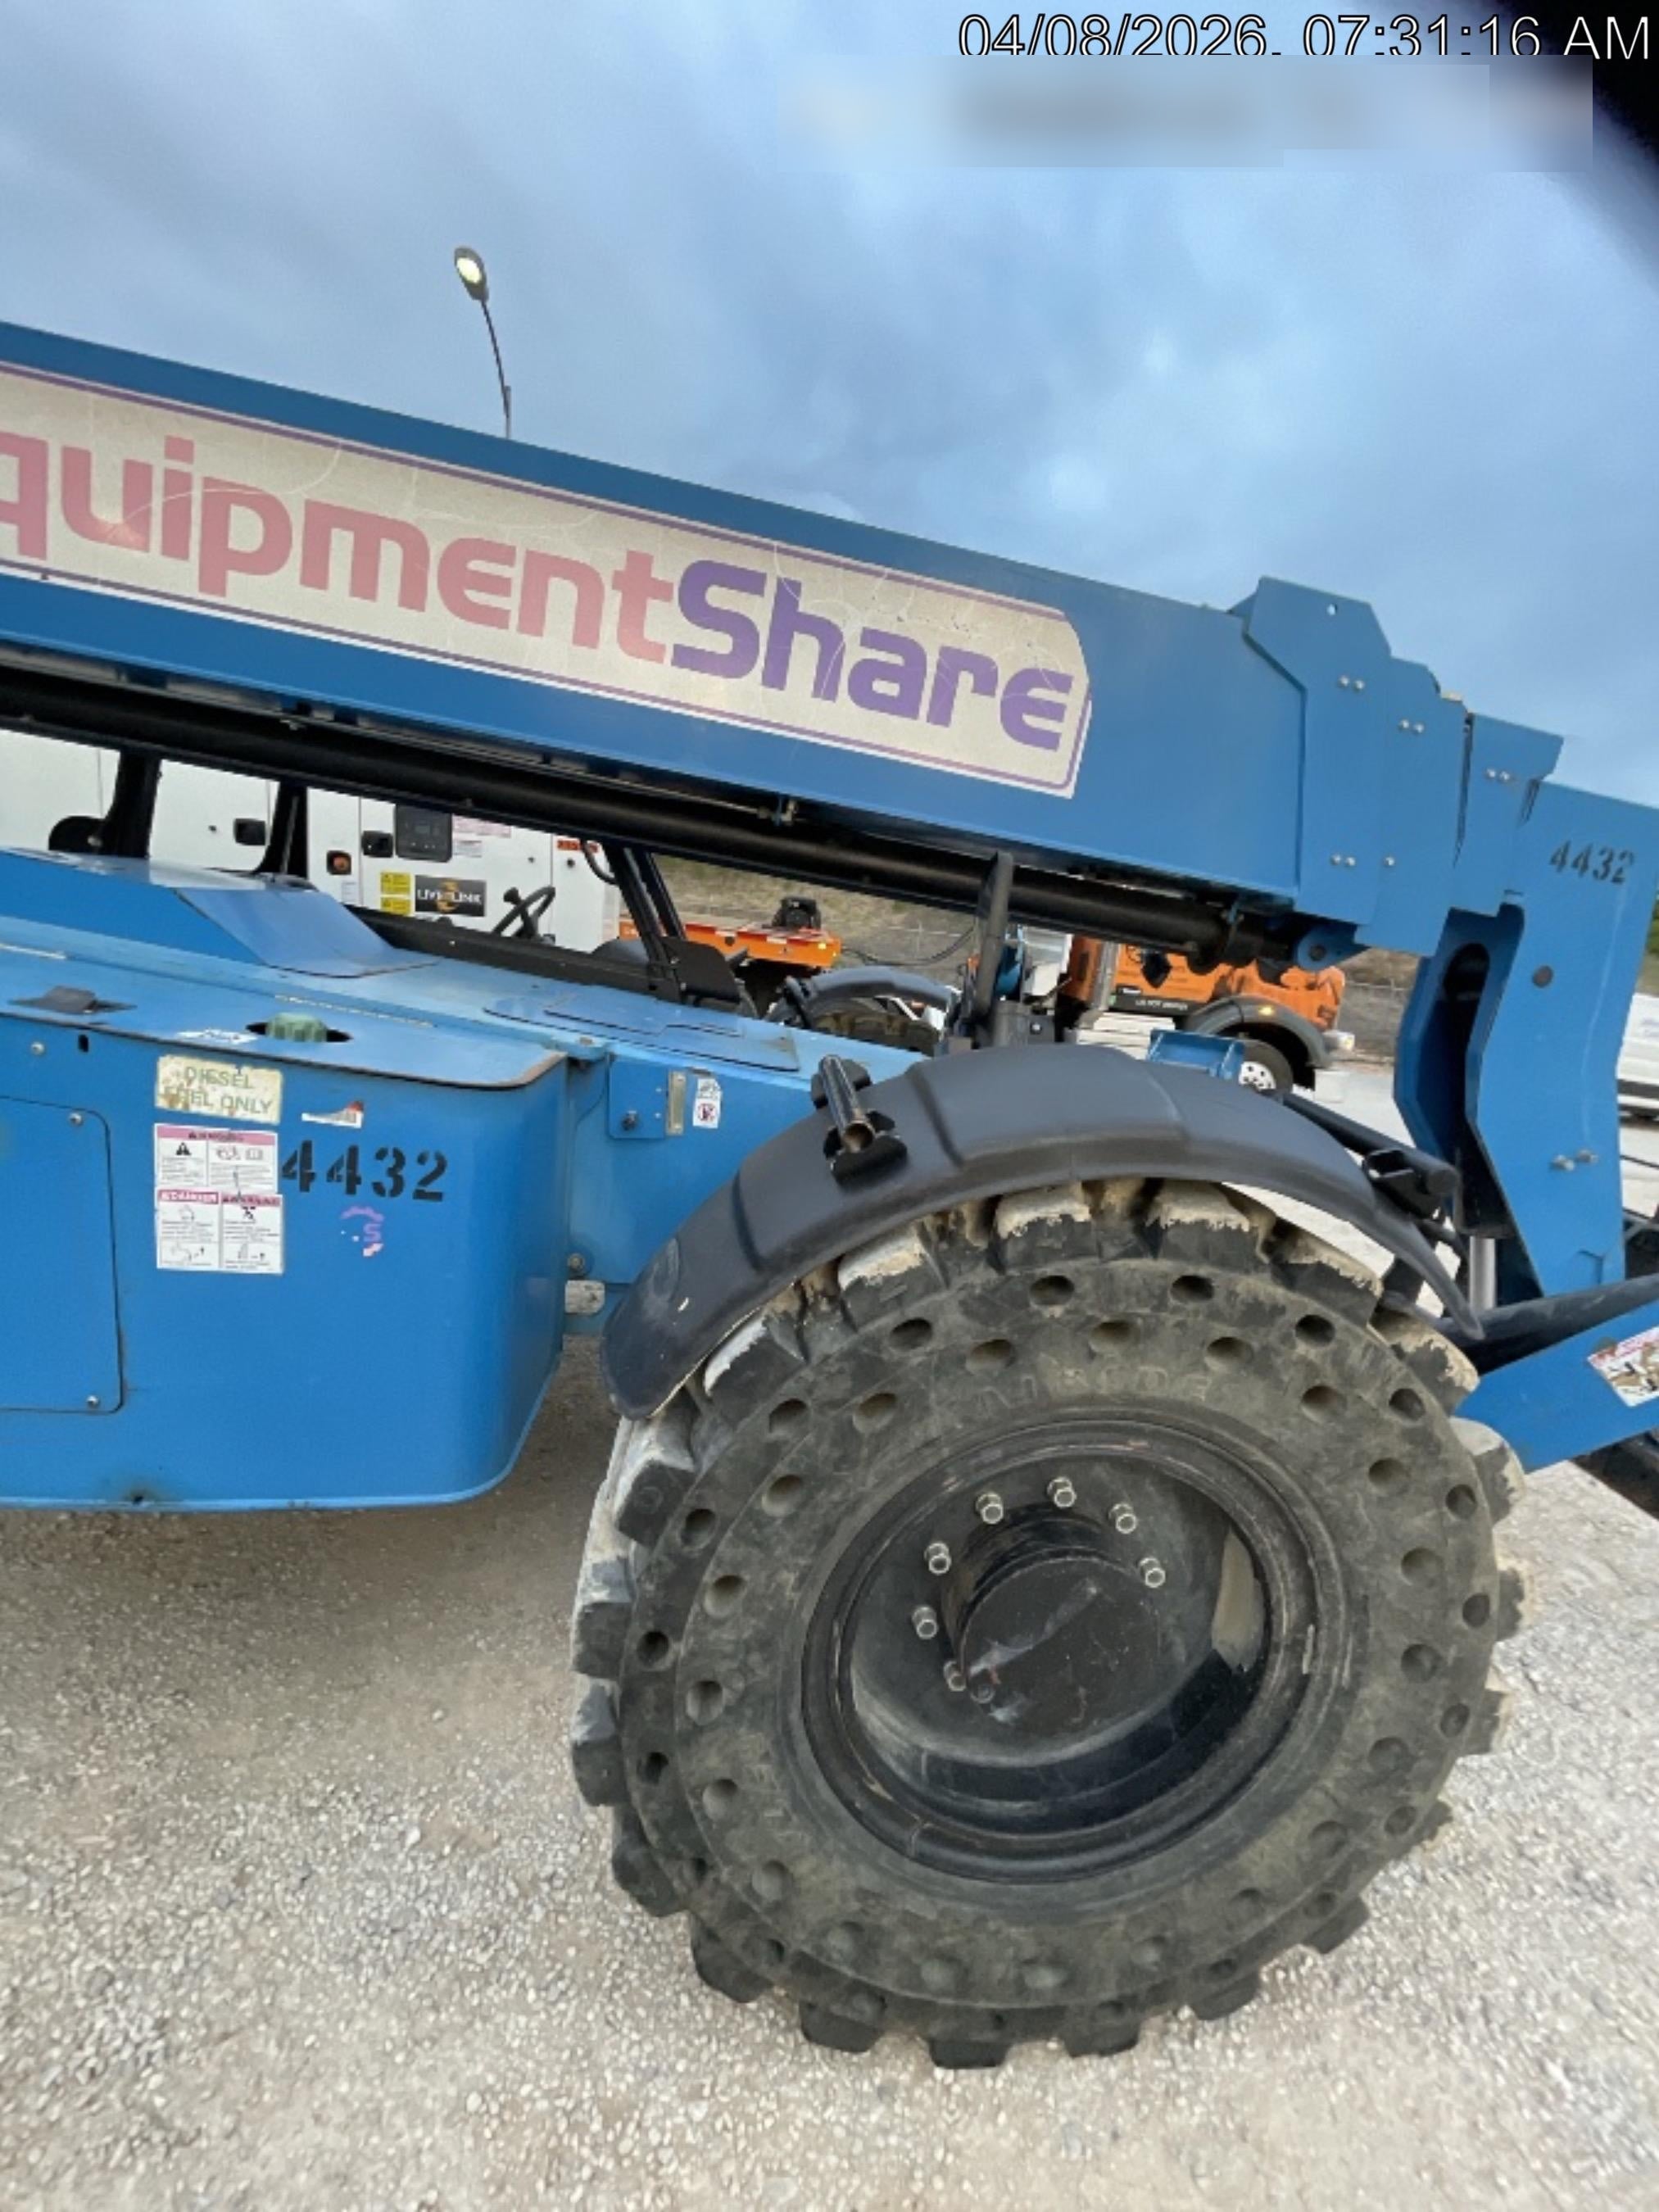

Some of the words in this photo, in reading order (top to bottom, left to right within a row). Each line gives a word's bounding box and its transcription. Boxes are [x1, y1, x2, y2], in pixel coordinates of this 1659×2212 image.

[1550, 840, 1635, 884] 4432
[183, 1067, 253, 1089] DIESEL
[220, 1094, 273, 1114] ONLY
[282, 1139, 448, 1203] 4432
